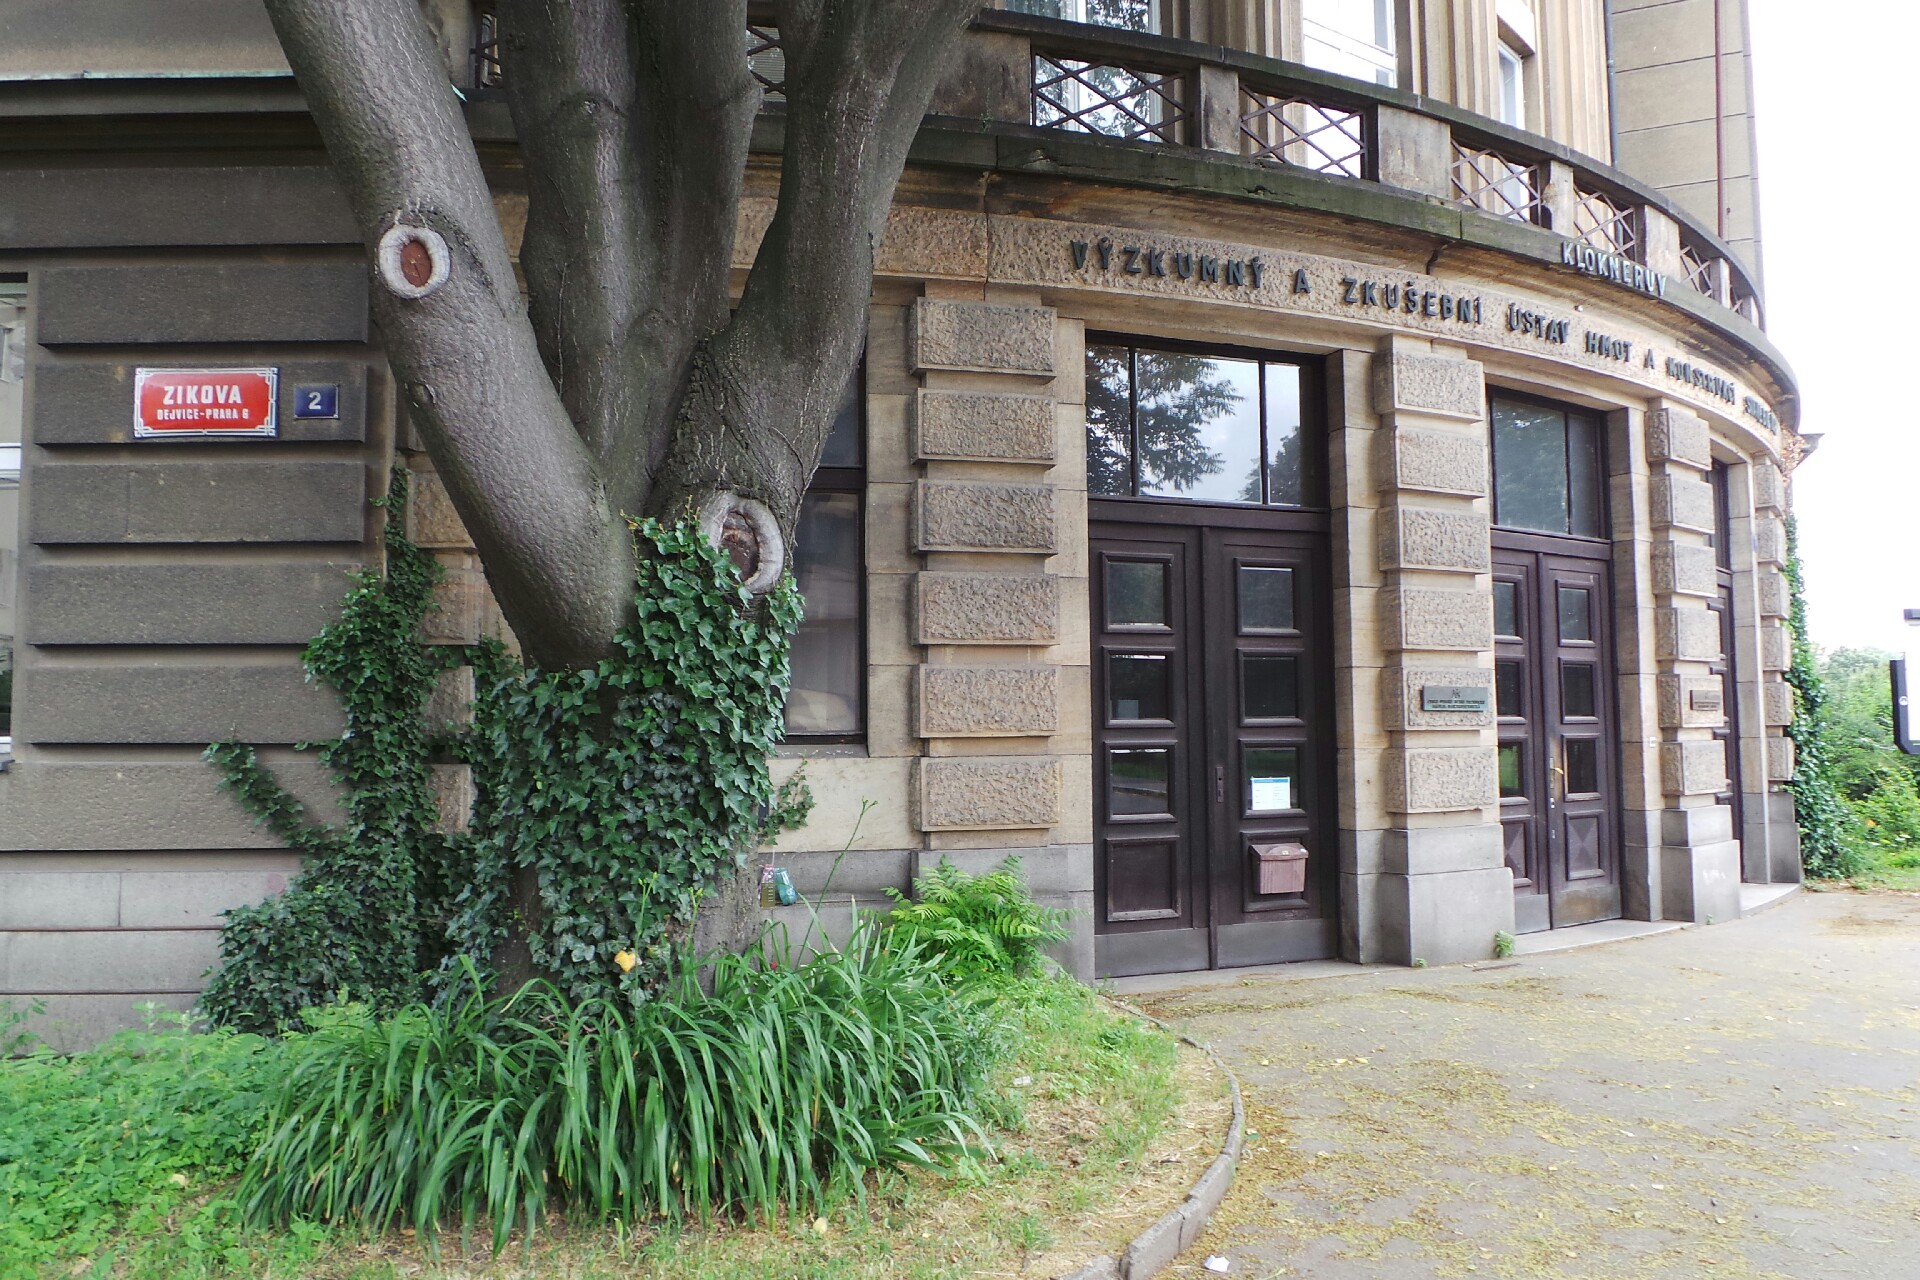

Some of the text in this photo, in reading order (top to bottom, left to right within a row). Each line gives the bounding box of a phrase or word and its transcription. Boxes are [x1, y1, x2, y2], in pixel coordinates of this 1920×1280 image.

[1070, 237, 1266, 289] VÝZKUMNÝ
[1294, 269, 1311, 294] A
[1342, 277, 1484, 325] ZKUŠEBNÍ
[1507, 302, 1569, 344] ÚSTAV
[1585, 330, 1632, 362] HMOT
[1643, 348, 1656, 370] A
[163, 385, 242, 405] ZIKOVA
[308, 392, 321, 410] 2
[242, 408, 249, 419] 6
